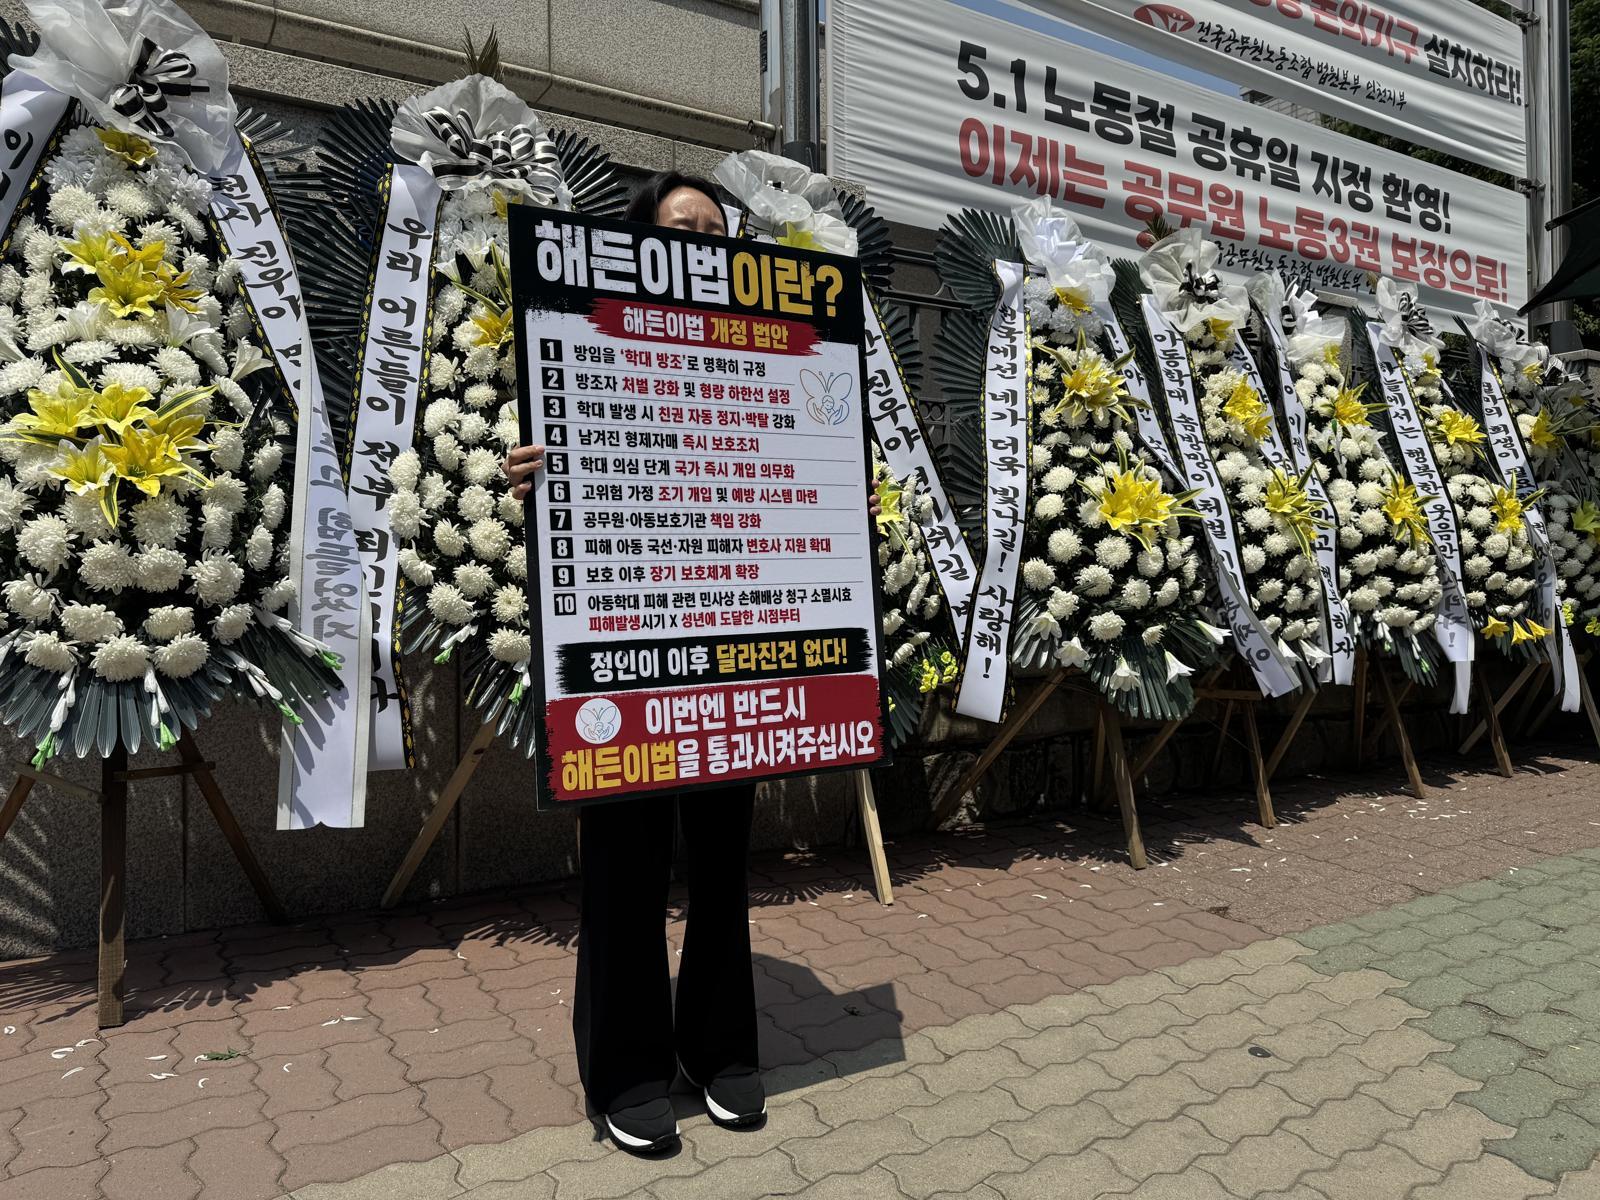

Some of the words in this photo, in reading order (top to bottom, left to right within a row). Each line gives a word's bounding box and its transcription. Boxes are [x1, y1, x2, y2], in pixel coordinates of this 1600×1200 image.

[1198, 21, 1314, 80] 전국공무원노동조합
[1317, 61, 1362, 92] 법원본부
[1366, 80, 1407, 110] 인천지부
[1423, 33, 1522, 106] 설치하라!
[957, 41, 1027, 113] 5.1
[1044, 66, 1176, 157] 노동절
[1188, 112, 1300, 193] 공휴일
[1310, 151, 1374, 213] 지정
[1382, 172, 1451, 234] 환영!
[958, 117, 1108, 209] 이제는
[1122, 160, 1246, 241] 공무원
[1258, 197, 1381, 274] 노동3권
[1392, 232, 1507, 304] 보장으로!
[386, 217, 432, 283] 우리
[534, 219, 843, 317] 해든이법이란?
[622, 306, 704, 341] 해든이법
[710, 316, 748, 345] 개정
[752, 323, 788, 350] 법안
[364, 296, 420, 425] 어른들이
[573, 344, 616, 367] 방임을
[618, 349, 651, 371] ‘학대
[656, 353, 699, 371] 방조’로
[701, 357, 738, 378] 명확히
[743, 361, 765, 377] 규정
[575, 373, 618, 393] 방조자
[620, 377, 648, 398] 처벌
[654, 380, 679, 396] 강화
[684, 382, 695, 397] 및
[700, 383, 724, 399] 형량
[728, 382, 766, 402] 하한선
[768, 388, 790, 404] 설정
[988, 389, 1026, 427] 네가
[577, 401, 605, 419] 학대
[610, 403, 636, 420] 발생
[641, 406, 653, 421] 시
[659, 406, 683, 423] 친권
[688, 409, 712, 425] 자동
[715, 407, 770, 431] 정지·박탈
[772, 414, 795, 429] 강화
[1154, 329, 1192, 405] 아동학대
[1173, 413, 1215, 488] 솜방망이
[1198, 496, 1227, 539] 처벌
[579, 429, 620, 446] 남겨진
[625, 428, 680, 449] 형제자매
[683, 435, 707, 450] 즉시
[712, 436, 759, 453] 보호조치
[989, 436, 1026, 477] 더욱
[1379, 361, 1422, 440] 하늘에서는
[1405, 447, 1443, 496] 행복한
[1428, 504, 1459, 560] 웃음만
[580, 456, 608, 474] 학대
[613, 458, 639, 474] 의심
[644, 459, 670, 475] 단계
[675, 461, 700, 476] 국가
[704, 462, 728, 477] 즉시
[733, 463, 756, 478] 개입
[761, 464, 795, 479] 의무화
[868, 368, 921, 453] 진우야
[927, 525, 970, 582] 쉬길
[582, 485, 622, 501] 고위험
[628, 485, 653, 501] 가정
[659, 486, 683, 502] 조기
[688, 487, 712, 502] 개입
[716, 487, 727, 502] 및
[732, 488, 755, 503] 예방
[759, 488, 792, 503] 시스템
[796, 489, 817, 504] 마련
[583, 512, 707, 528] 공무원·아동보호기관
[710, 513, 734, 528] 책임
[738, 513, 761, 528] 강화
[989, 486, 1024, 573] 빛나길!
[585, 539, 612, 555] 피해
[617, 539, 643, 555] 아동
[647, 538, 703, 554] 국선·자원
[707, 538, 743, 554] 피해자
[747, 538, 781, 553] 변호사
[785, 538, 806, 553] 지원
[810, 538, 831, 552] 확대
[586, 566, 614, 583] 보호
[619, 566, 646, 582] 이후
[650, 566, 676, 582] 장기
[681, 565, 731, 580] 보호체계
[736, 564, 759, 579] 확장
[588, 594, 639, 611] 아동학대
[644, 593, 668, 609] 피해
[672, 592, 696, 608] 관련
[700, 591, 735, 607] 민사상
[738, 590, 783, 606] 손해배상
[786, 589, 807, 604] 청구
[811, 587, 852, 602] 소멸시효
[589, 610, 665, 632] 피해발생시기
[669, 614, 678, 627] X
[682, 612, 716, 628] 성년에
[720, 610, 754, 625] 도달한
[758, 608, 800, 624] 시점부터
[974, 584, 1013, 679] 사랑해!
[590, 651, 659, 683] 정인이
[668, 647, 709, 676] 이후
[716, 640, 797, 674] 달라진건
[803, 638, 847, 666] 없다!
[645, 693, 725, 735] 이번엔
[733, 685, 806, 729] 반드시
[562, 737, 700, 792] 해든이법을
[707, 721, 875, 775] 통과시켜주십시오
